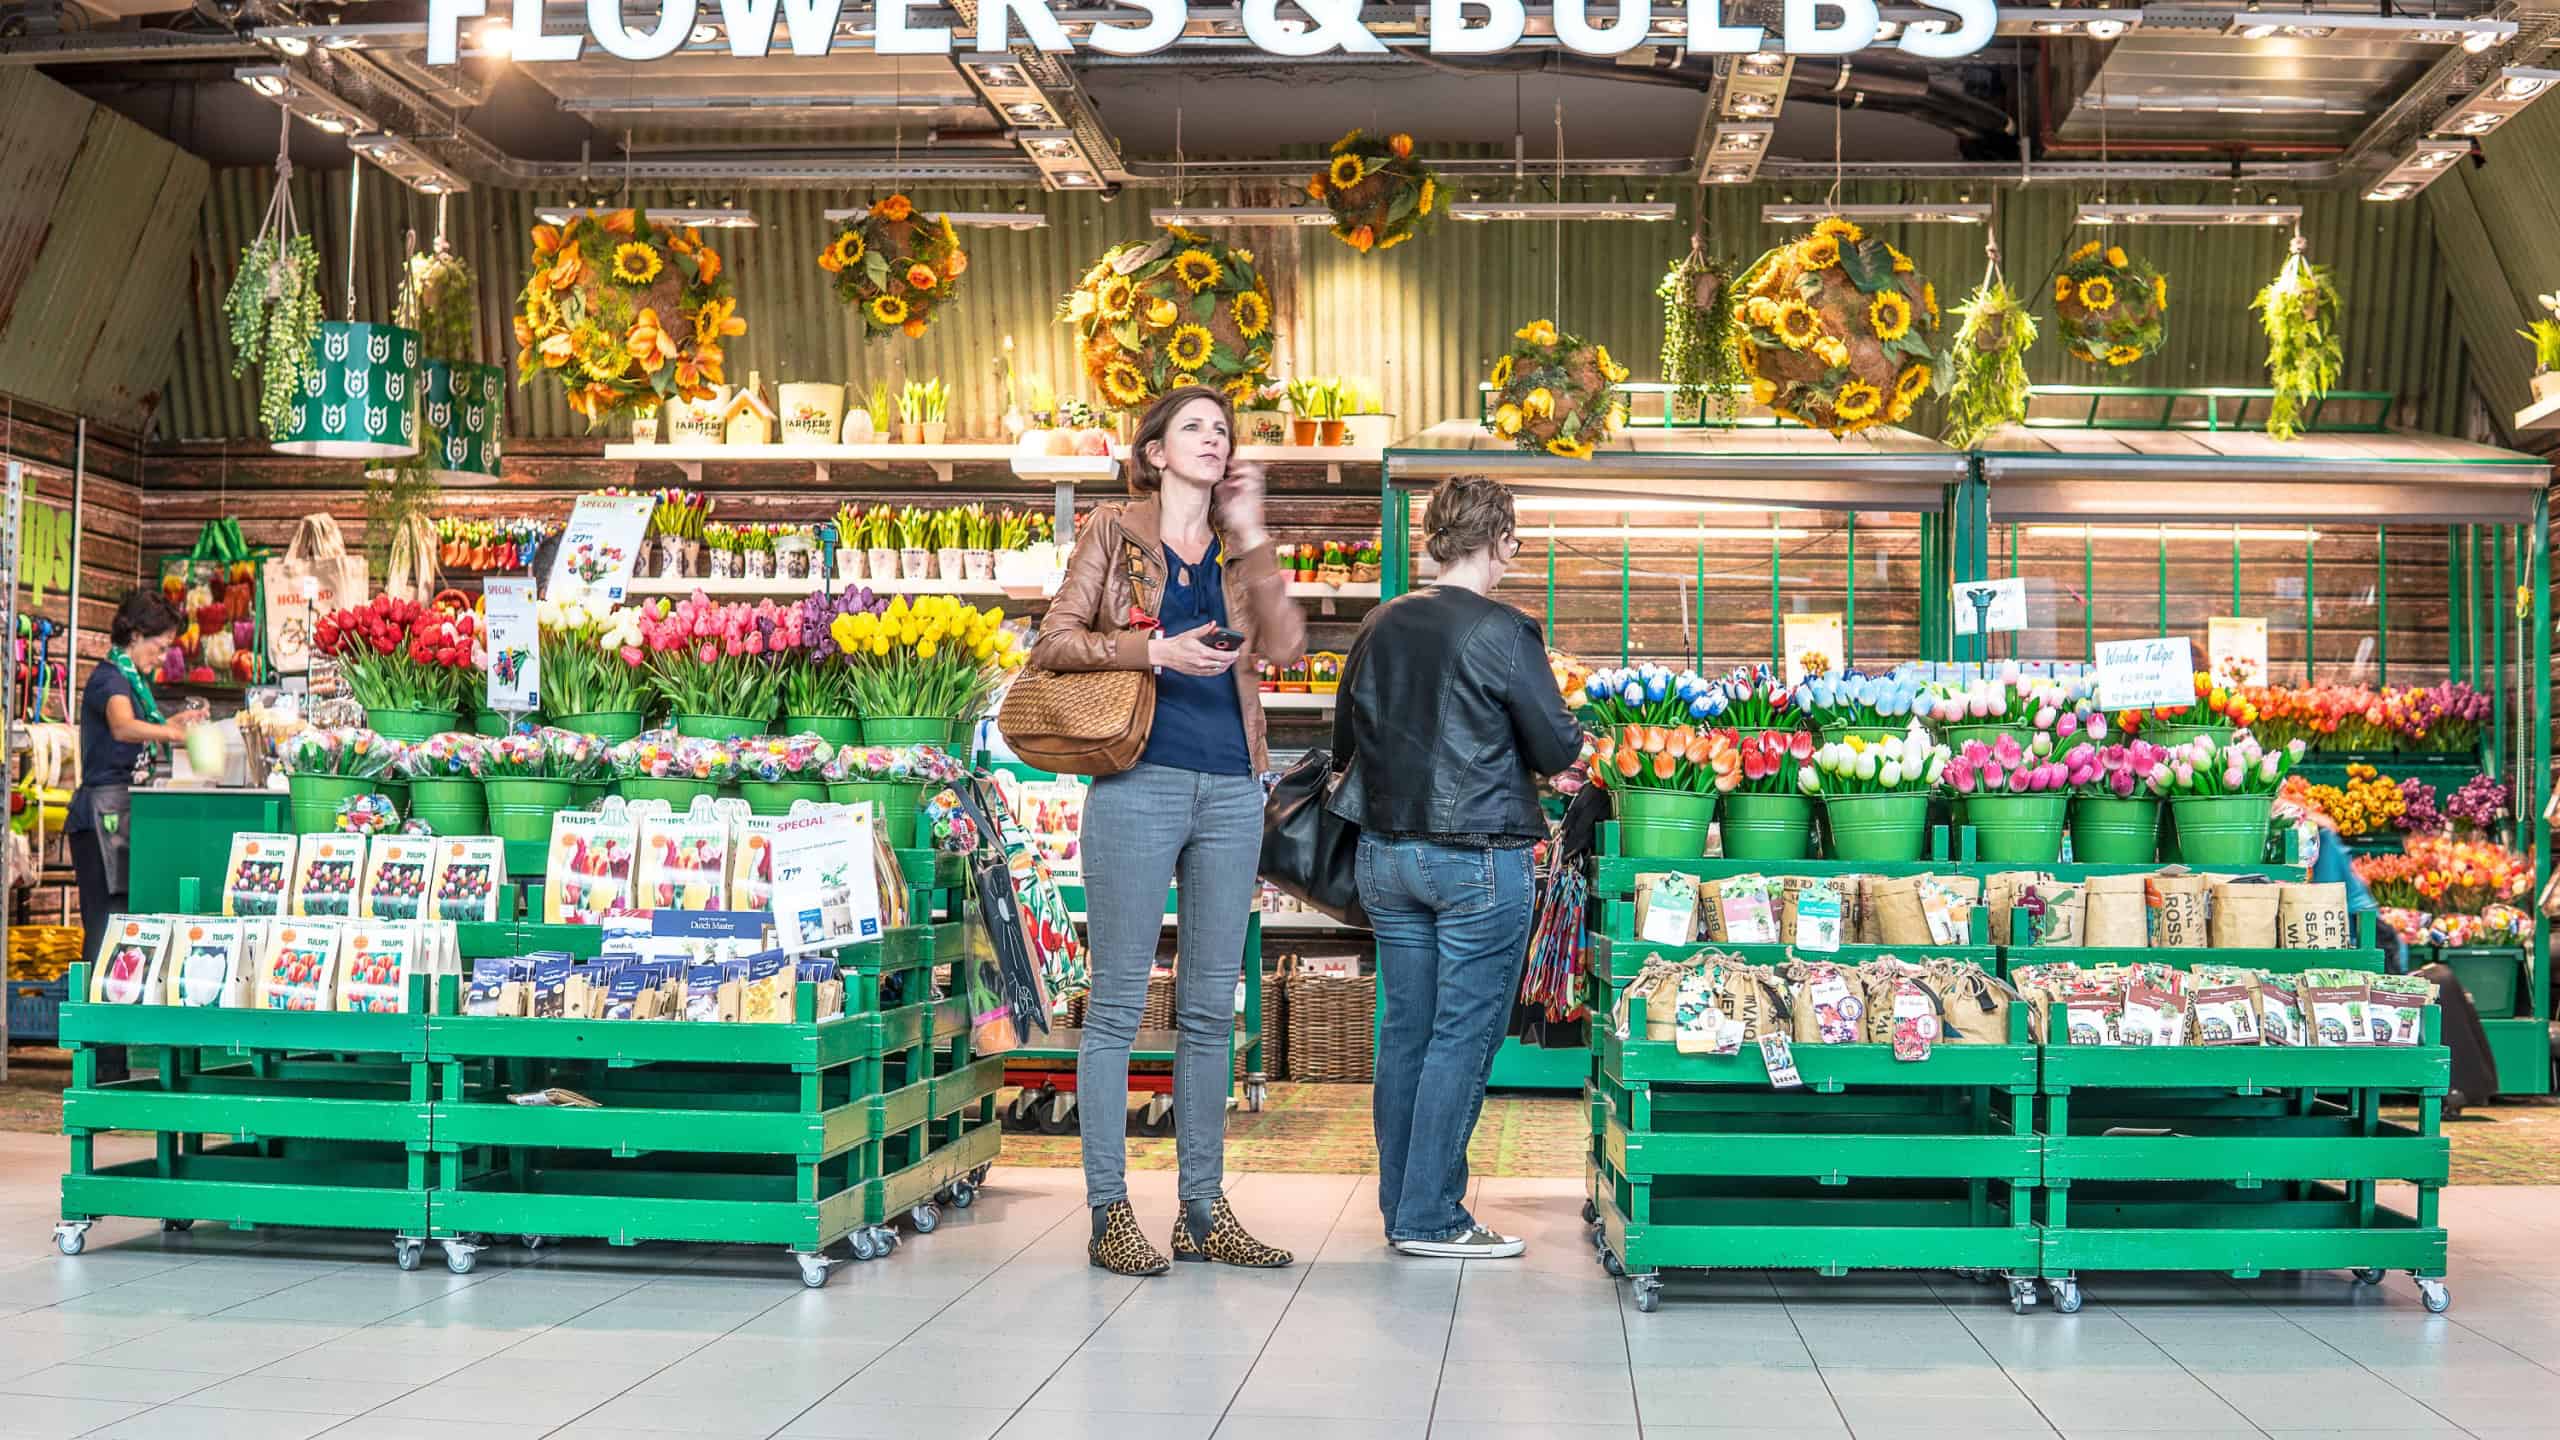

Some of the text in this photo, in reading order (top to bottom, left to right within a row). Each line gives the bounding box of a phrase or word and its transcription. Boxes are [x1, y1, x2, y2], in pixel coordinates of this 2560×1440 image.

[487, 585, 512, 594] SPECIAL
[278, 590, 333, 605] HOLND
[560, 815, 597, 824] TULIPS
[777, 815, 825, 832] SPECIAL
[265, 849, 285, 857] TULIPS
[335, 849, 356, 857] TULIPS
[406, 851, 427, 859] TULIPS
[140, 933, 161, 941] TULIPS
[212, 933, 233, 941] TULIPS
[307, 938, 329, 946] TULIPS
[381, 939, 404, 947] TULIPS
